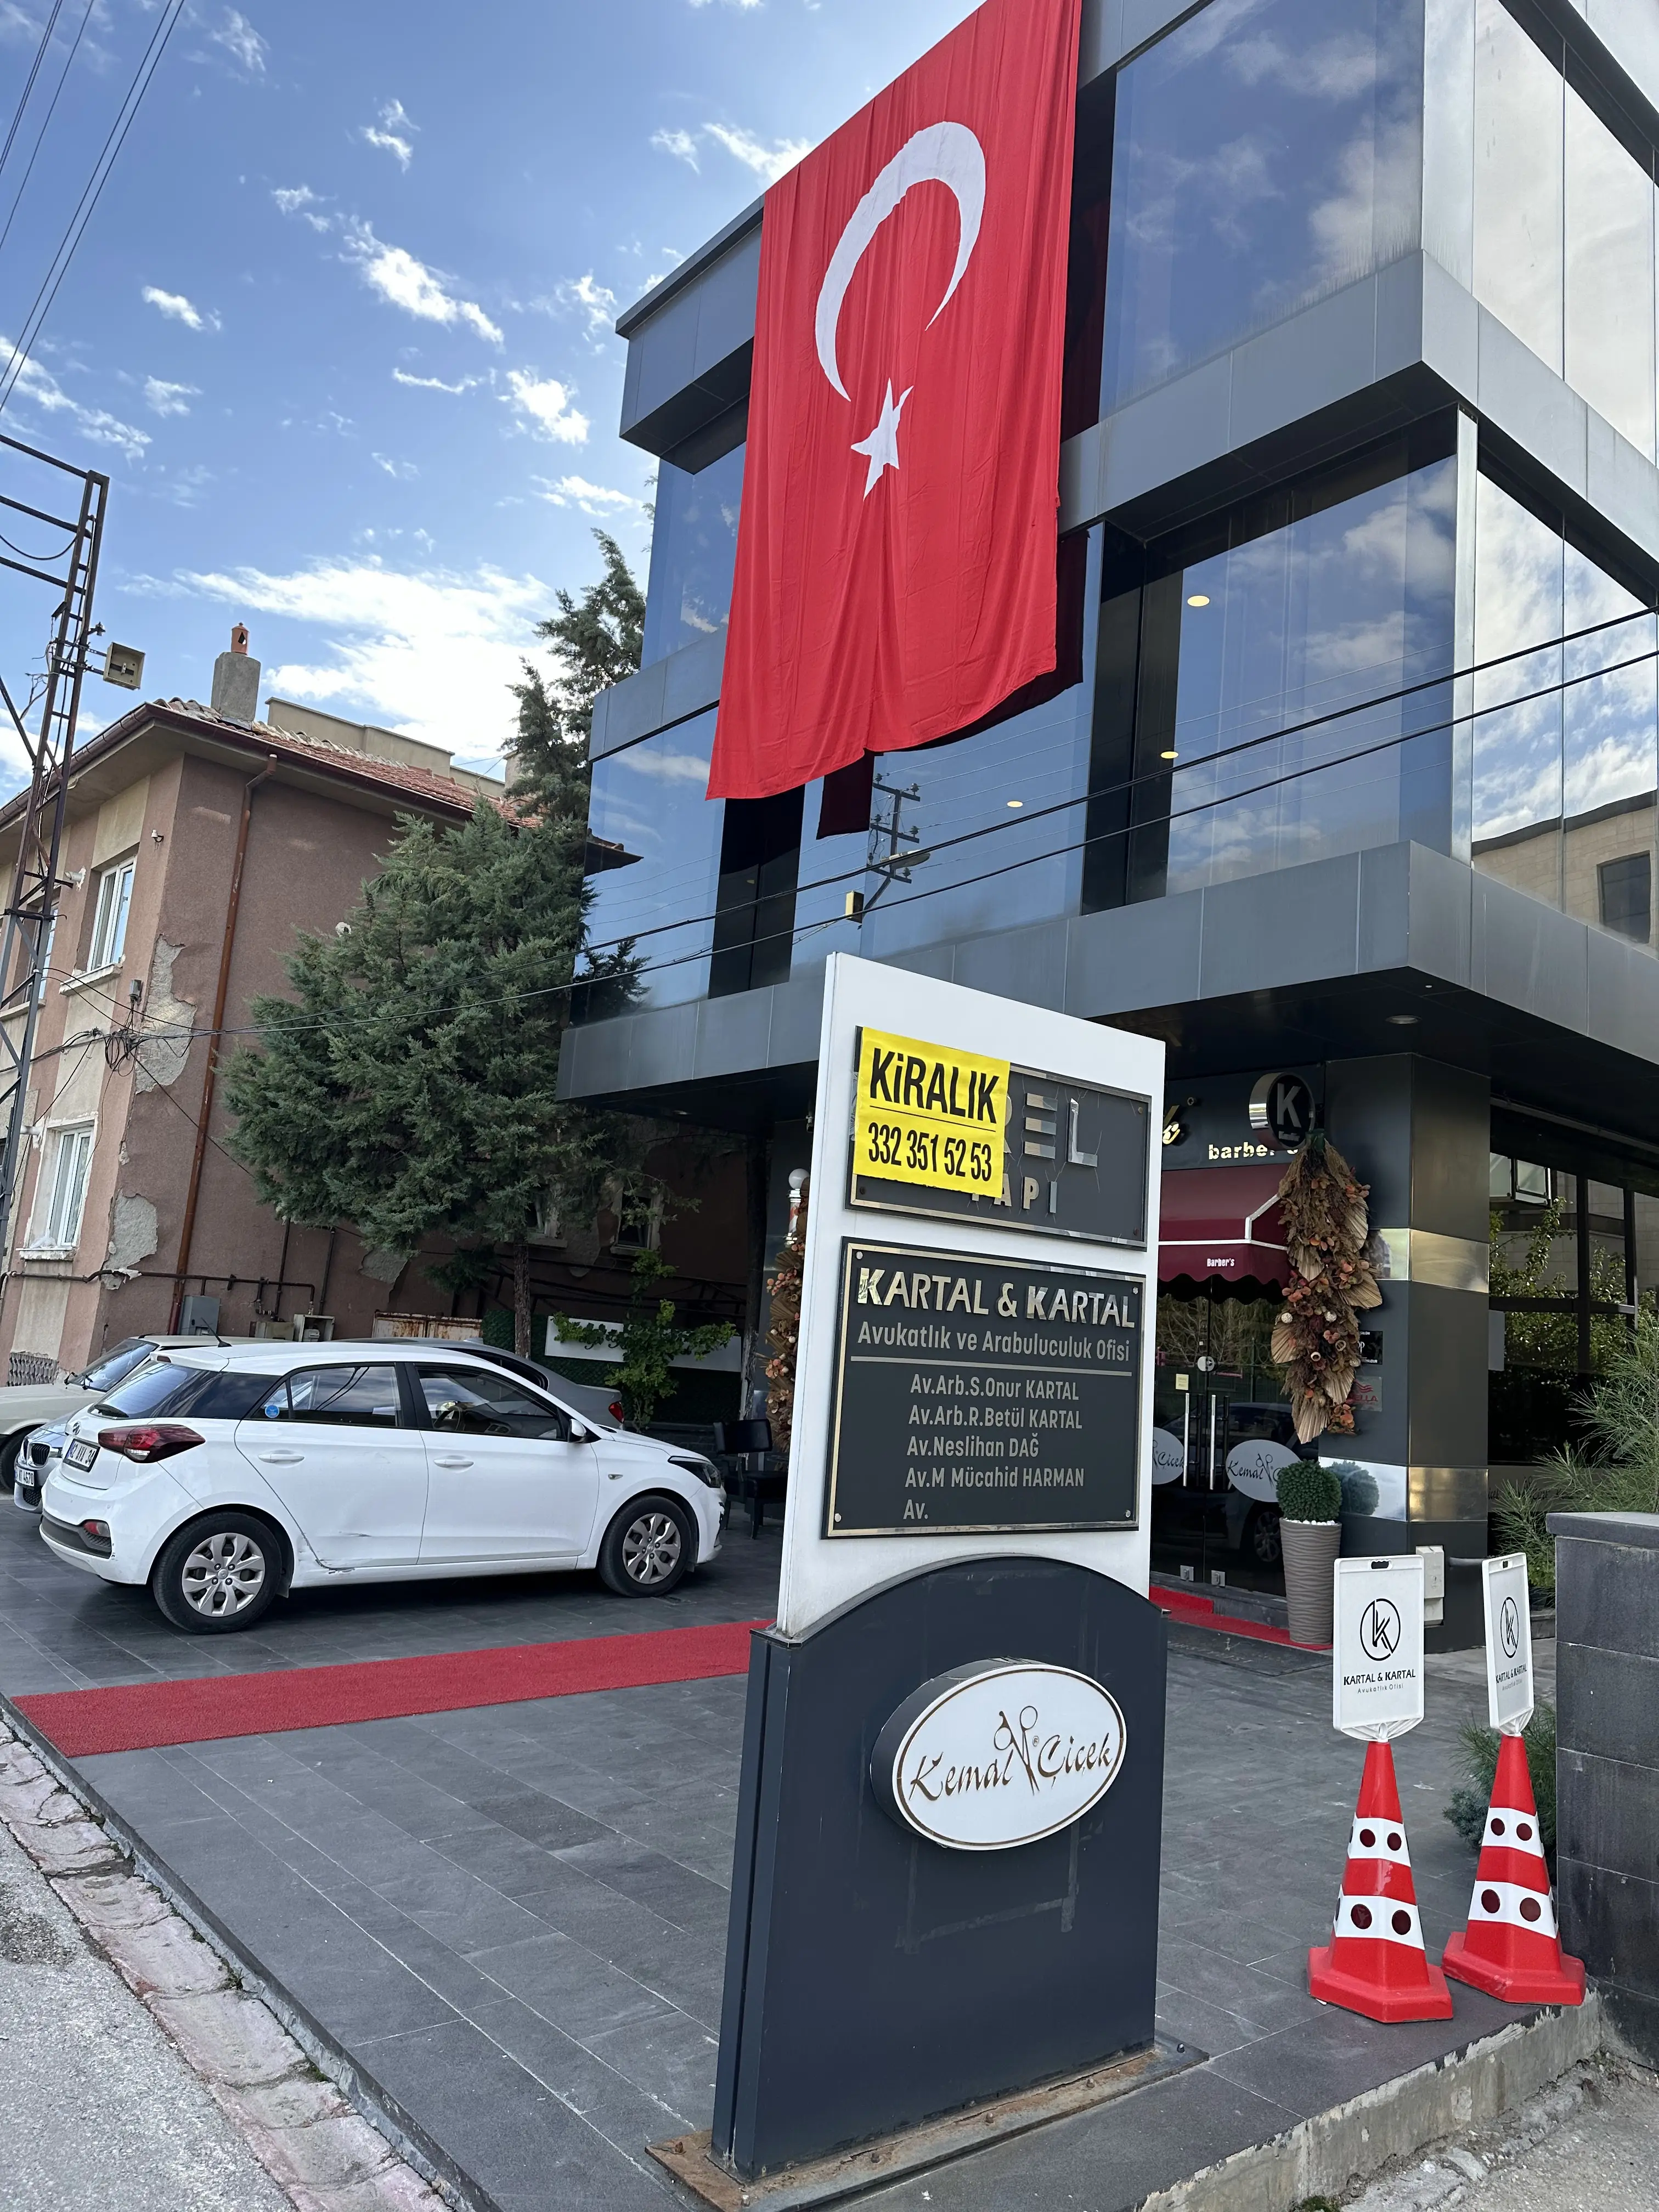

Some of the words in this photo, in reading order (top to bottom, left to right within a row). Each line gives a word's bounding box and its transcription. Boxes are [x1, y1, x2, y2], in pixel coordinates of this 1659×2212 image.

[1277, 1083, 1301, 1127] K
[1005, 1093, 1098, 1167] EL
[868, 1122, 902, 1166] 332
[906, 1130, 939, 1172] 351
[944, 1137, 966, 1177] 52
[970, 1142, 992, 1182] 53
[1207, 1258, 1235, 1267] Barber's
[857, 1267, 989, 1314] KARTAL
[997, 1283, 1017, 1317] &
[1026, 1285, 1135, 1328] KARTAL
[857, 1321, 951, 1349] Avukatlık
[957, 1332, 978, 1351] ve
[982, 1330, 1092, 1359] Arabuluculuk
[1097, 1339, 1130, 1361] Ofisi
[1026, 1380, 1079, 1400] KARTAL
[1029, 1409, 1082, 1429] KARTAL
[907, 1435, 1004, 1457] Av.Neslihan
[1009, 1432, 1039, 1457] DAĞ
[905, 1467, 945, 1487] Av.M
[951, 1465, 1018, 1487] Mücahid
[1023, 1468, 1084, 1487] HARMAN
[1228, 1460, 1263, 1480] Kemal
[903, 1499, 928, 1519] Av.
[1344, 1673, 1375, 1685] KARTAL
[1378, 1672, 1383, 1681] &
[1385, 1669, 1416, 1680] KARTAL
[909, 1749, 1013, 1801] Kemal
